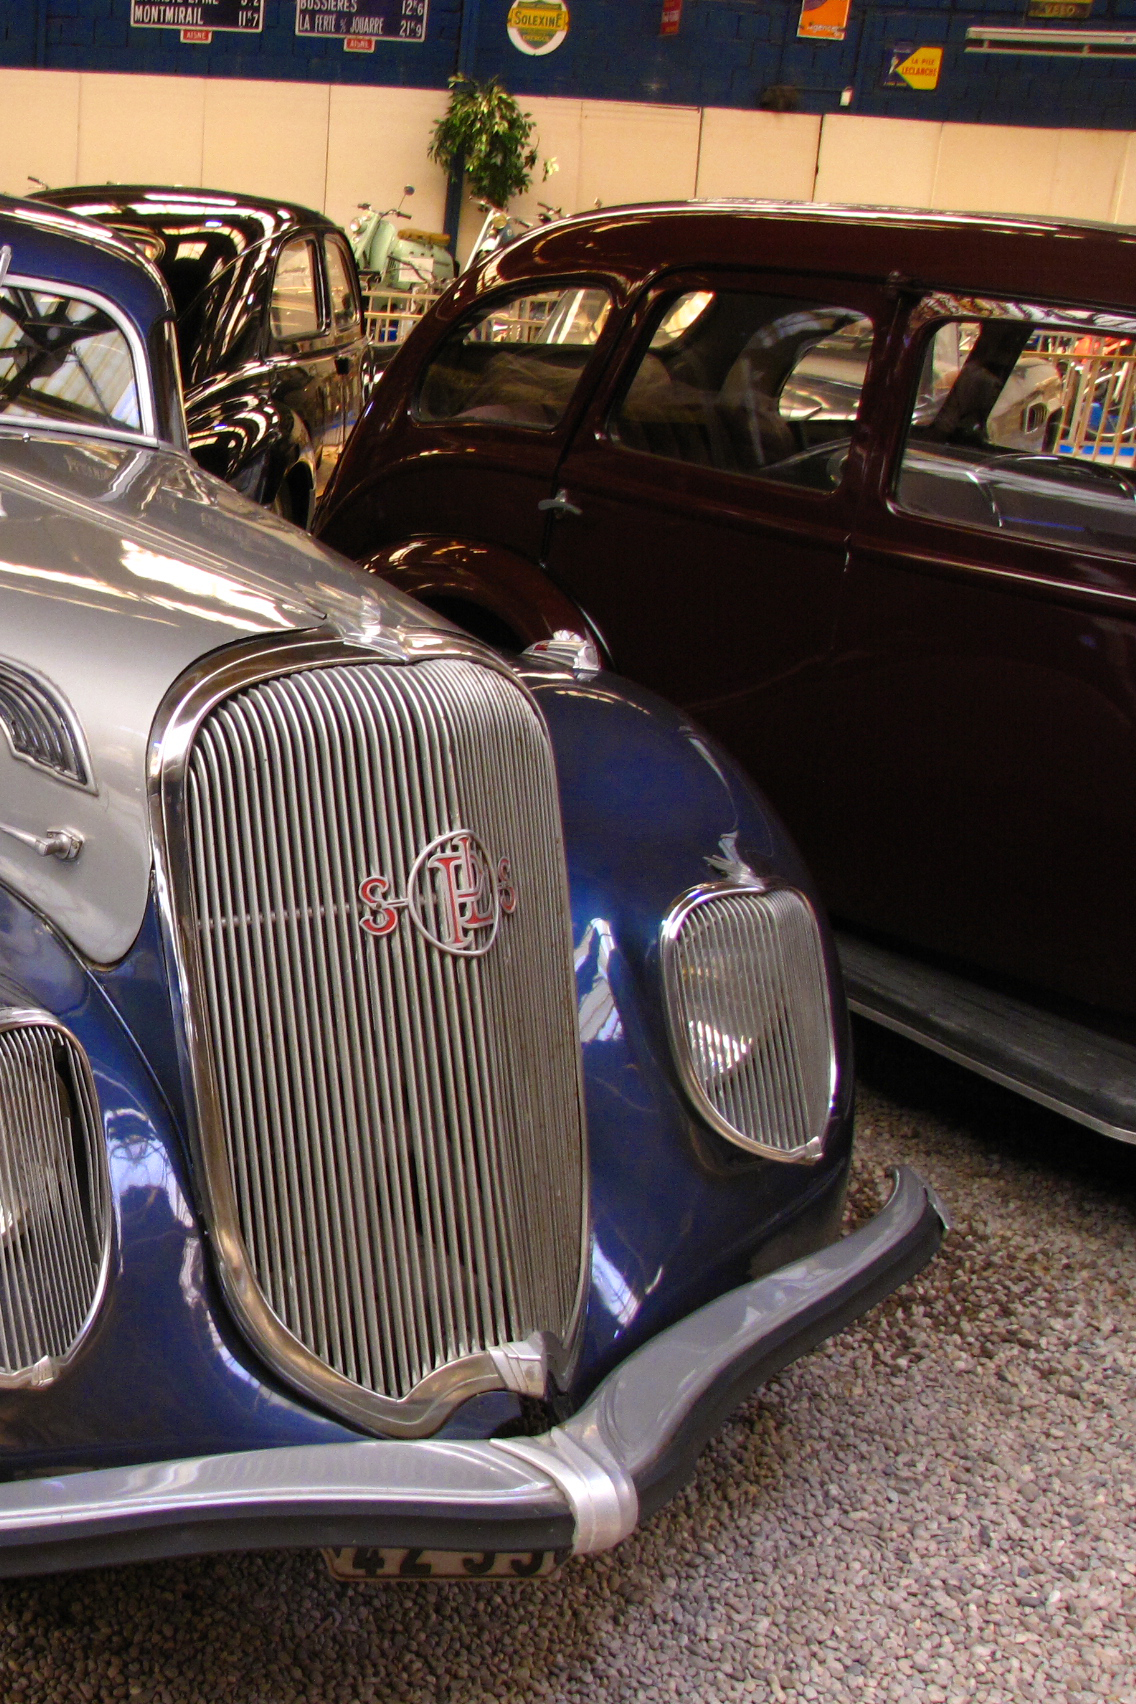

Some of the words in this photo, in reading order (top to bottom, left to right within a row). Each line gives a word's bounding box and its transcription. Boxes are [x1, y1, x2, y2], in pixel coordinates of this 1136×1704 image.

[134, 5, 204, 25] MONTMIRAIL
[299, 13, 310, 31] LA
[349, 17, 384, 35] JOUARRE
[514, 10, 562, 28] SOLEXINE
